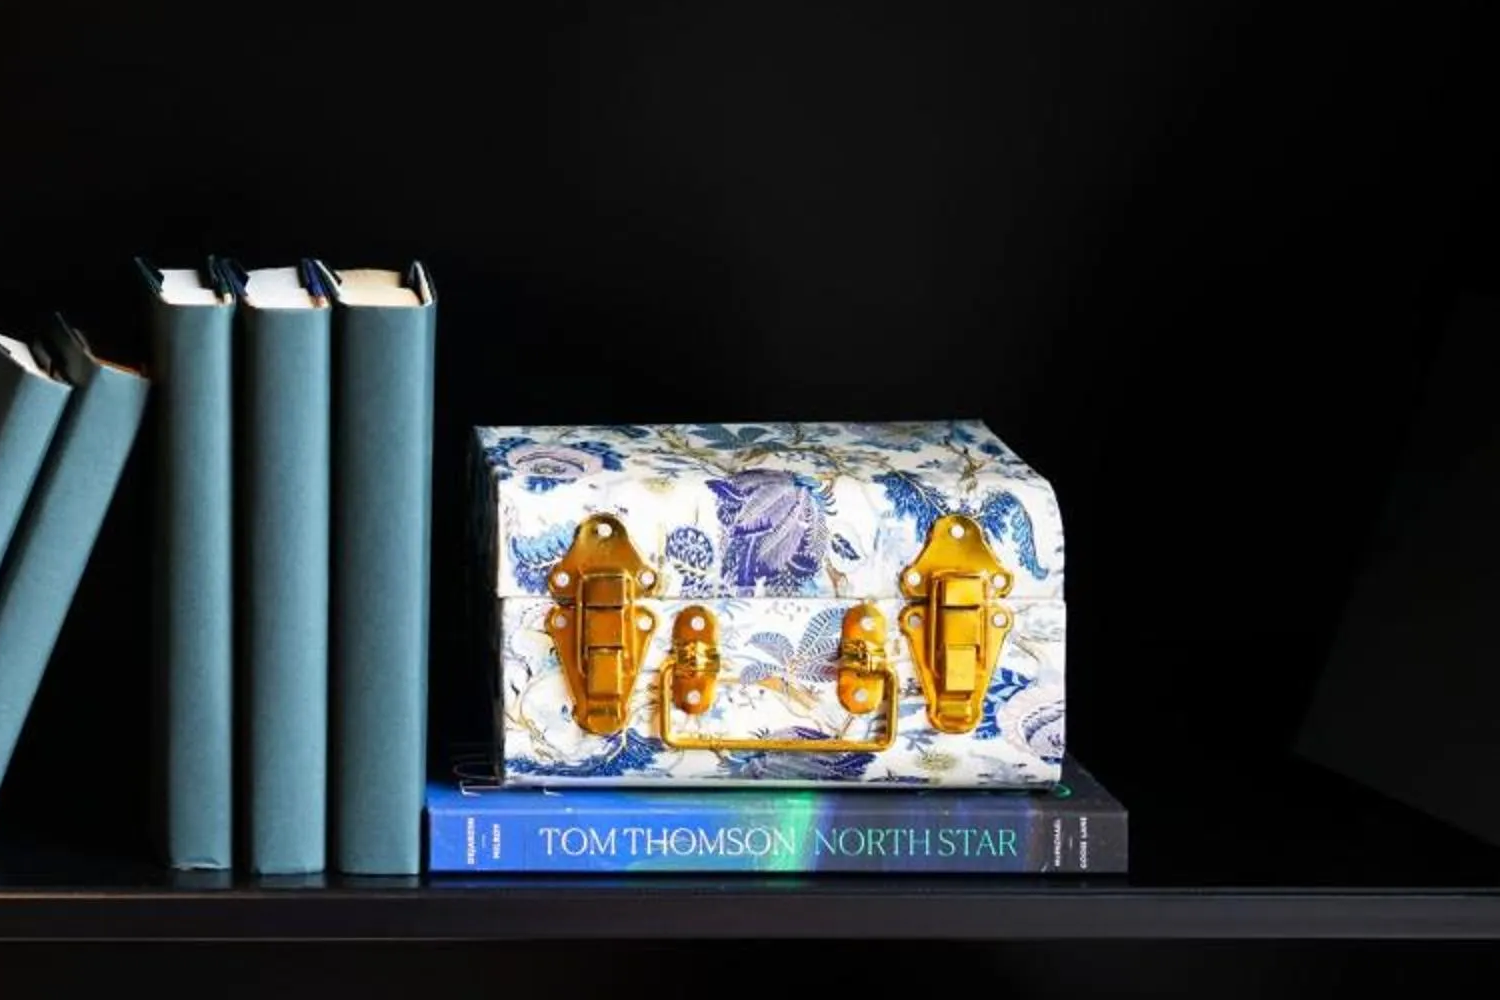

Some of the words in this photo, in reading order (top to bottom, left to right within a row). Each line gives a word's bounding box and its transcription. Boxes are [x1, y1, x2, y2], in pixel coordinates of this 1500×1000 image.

[538, 826, 617, 857] TOM
[623, 826, 797, 857] THOMSON
[813, 826, 932, 857] NORTH
[938, 827, 1019, 857] STAR
